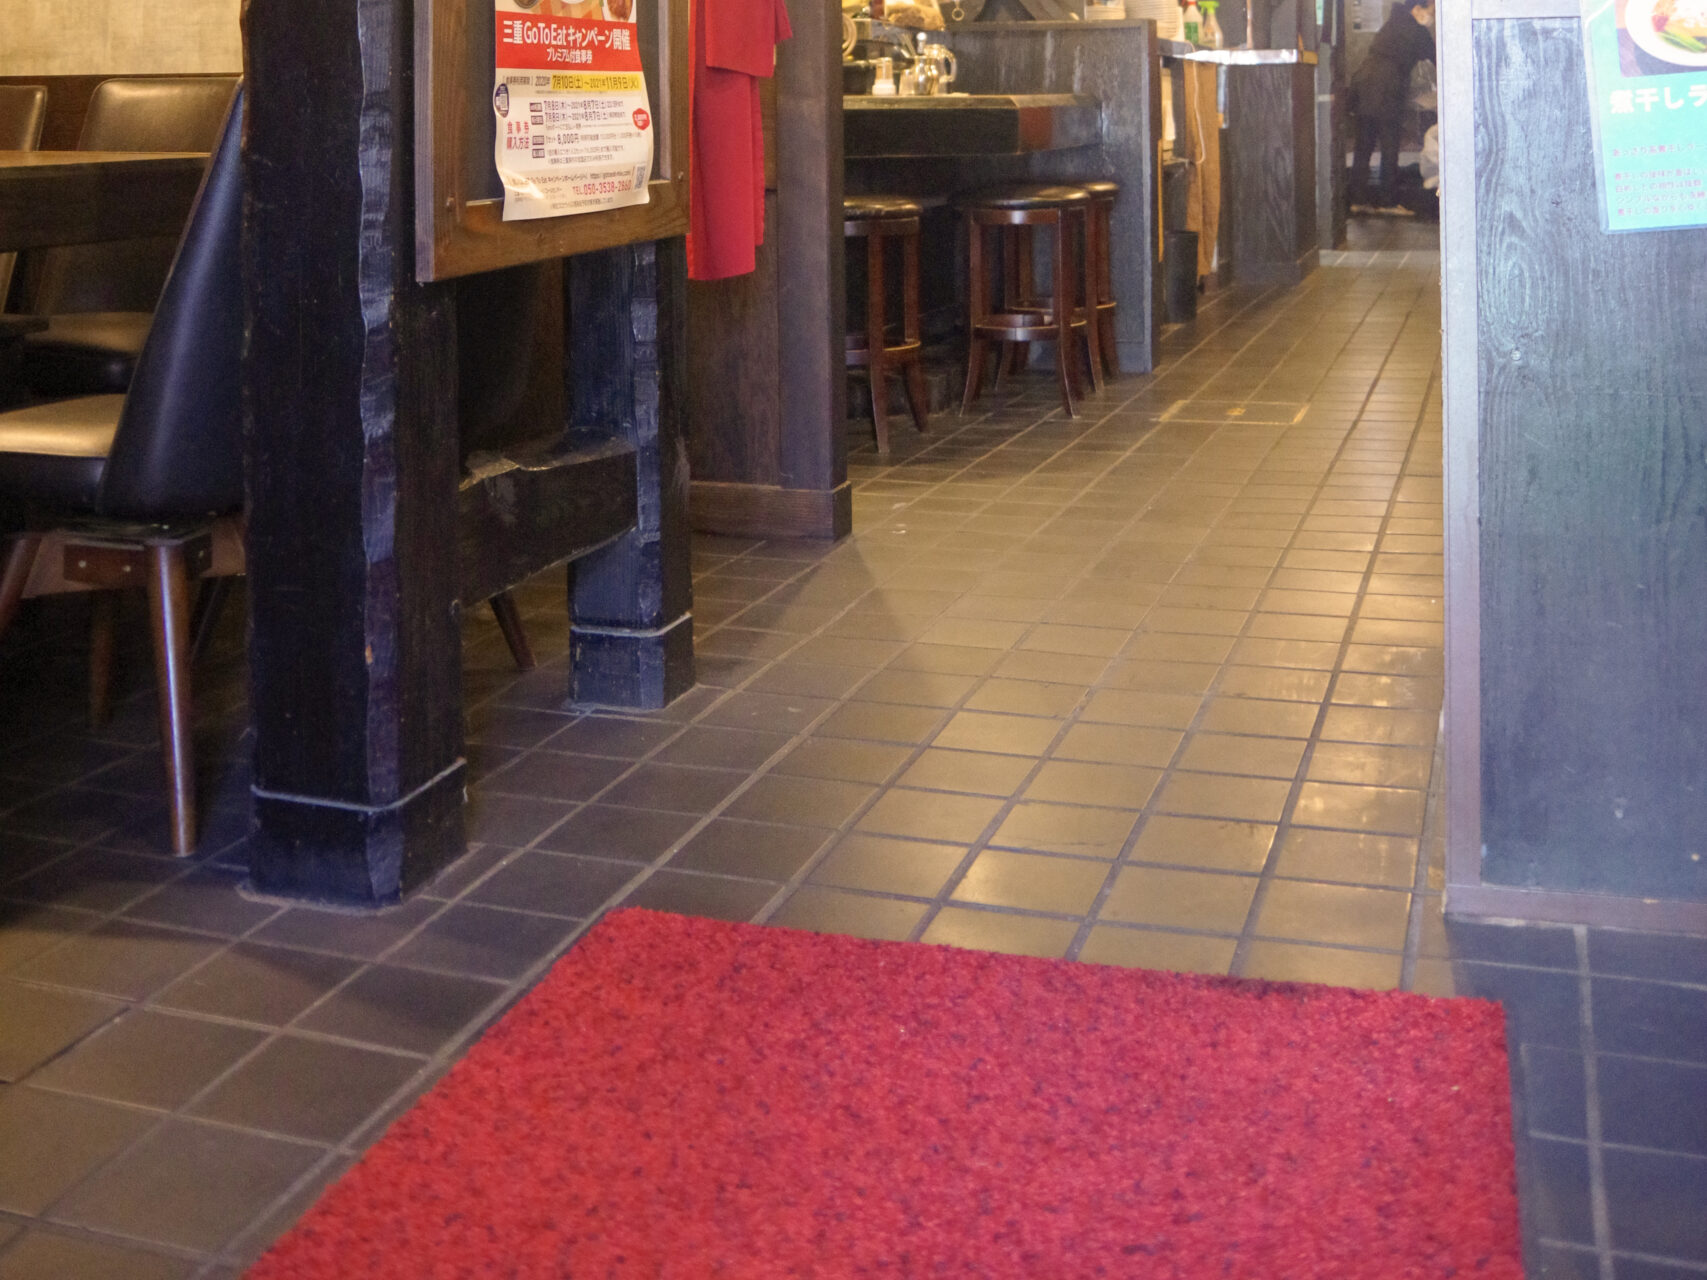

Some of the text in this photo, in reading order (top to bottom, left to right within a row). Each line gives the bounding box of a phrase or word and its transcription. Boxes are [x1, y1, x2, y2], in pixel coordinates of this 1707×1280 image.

[547, 48, 592, 64] プレミアム付食事券
